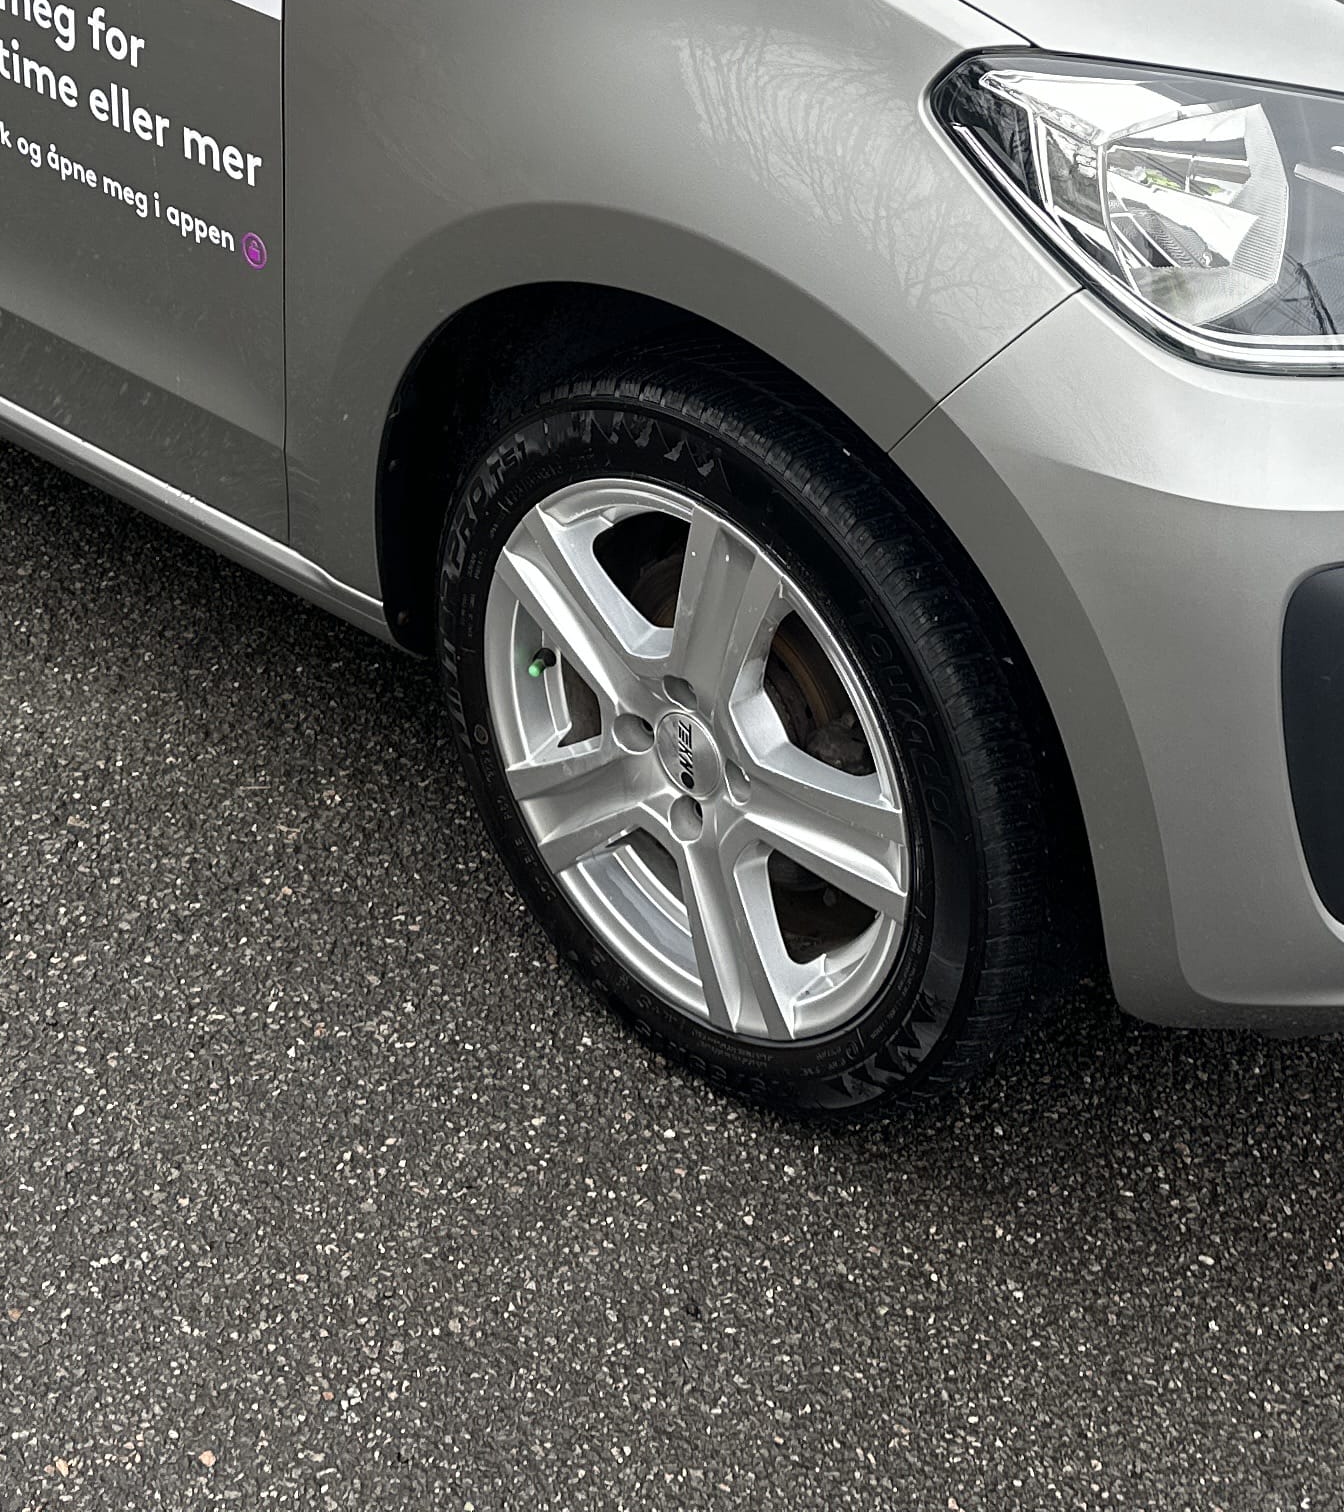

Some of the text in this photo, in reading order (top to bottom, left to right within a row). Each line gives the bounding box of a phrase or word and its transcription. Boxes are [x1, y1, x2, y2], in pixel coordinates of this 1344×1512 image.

[87, 7, 145, 67] for
[90, 82, 169, 147] eller
[184, 124, 262, 187] mer
[17, 136, 41, 167] og
[47, 145, 97, 191] åpne
[103, 177, 148, 217] meg
[154, 193, 161, 217] i
[166, 206, 234, 252] appen
